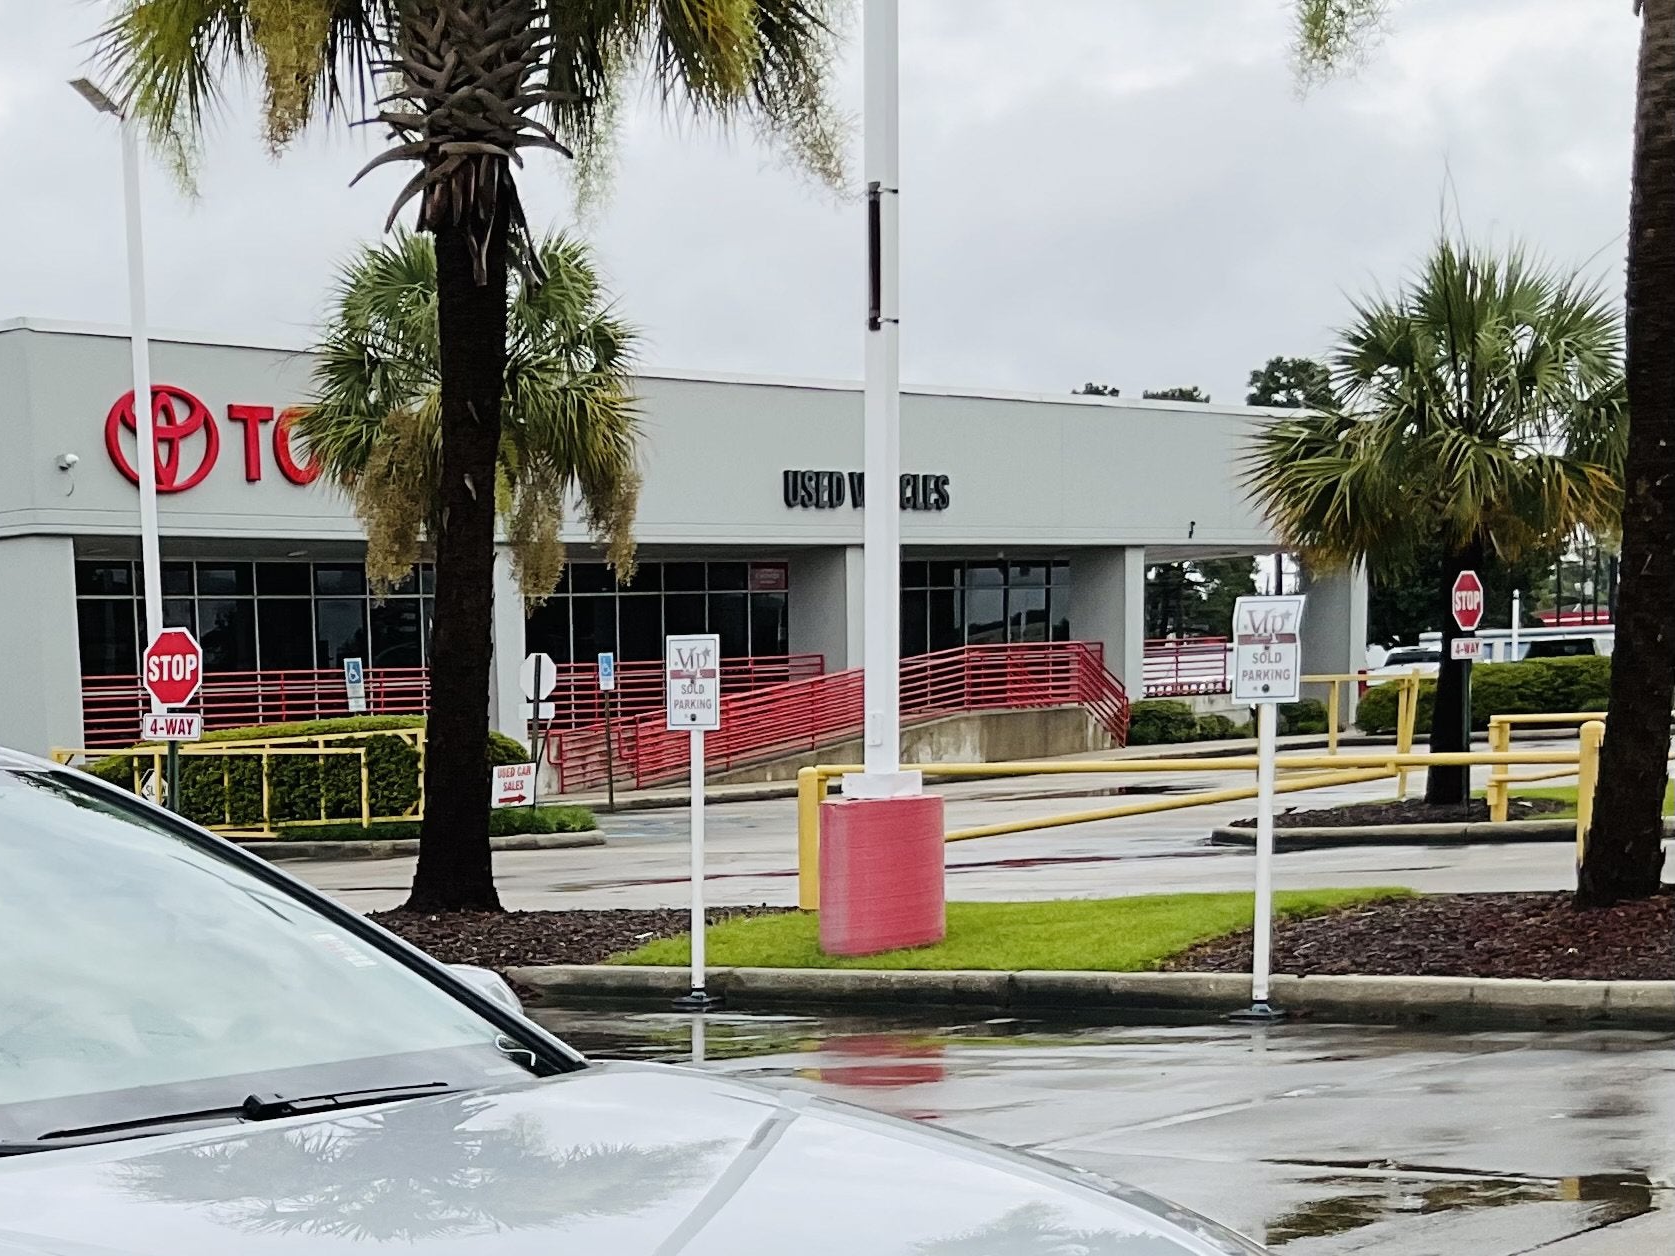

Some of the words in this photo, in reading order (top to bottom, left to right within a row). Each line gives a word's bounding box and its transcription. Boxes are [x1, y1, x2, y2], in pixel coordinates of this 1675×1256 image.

[783, 470, 846, 508] USED
[848, 472, 950, 511] VCLES
[1455, 590, 1480, 611] STOP
[1455, 642, 1480, 654] 4-WAY
[1252, 652, 1282, 664] SOLD
[148, 654, 198, 682] STOP
[1241, 669, 1291, 681] PARKING
[681, 684, 705, 695] SOLD
[673, 699, 712, 710] PARKING
[150, 718, 194, 735] 4-WAY
[497, 766, 516, 778] USED
[517, 765, 532, 777] CAR
[503, 779, 524, 792] SALES
